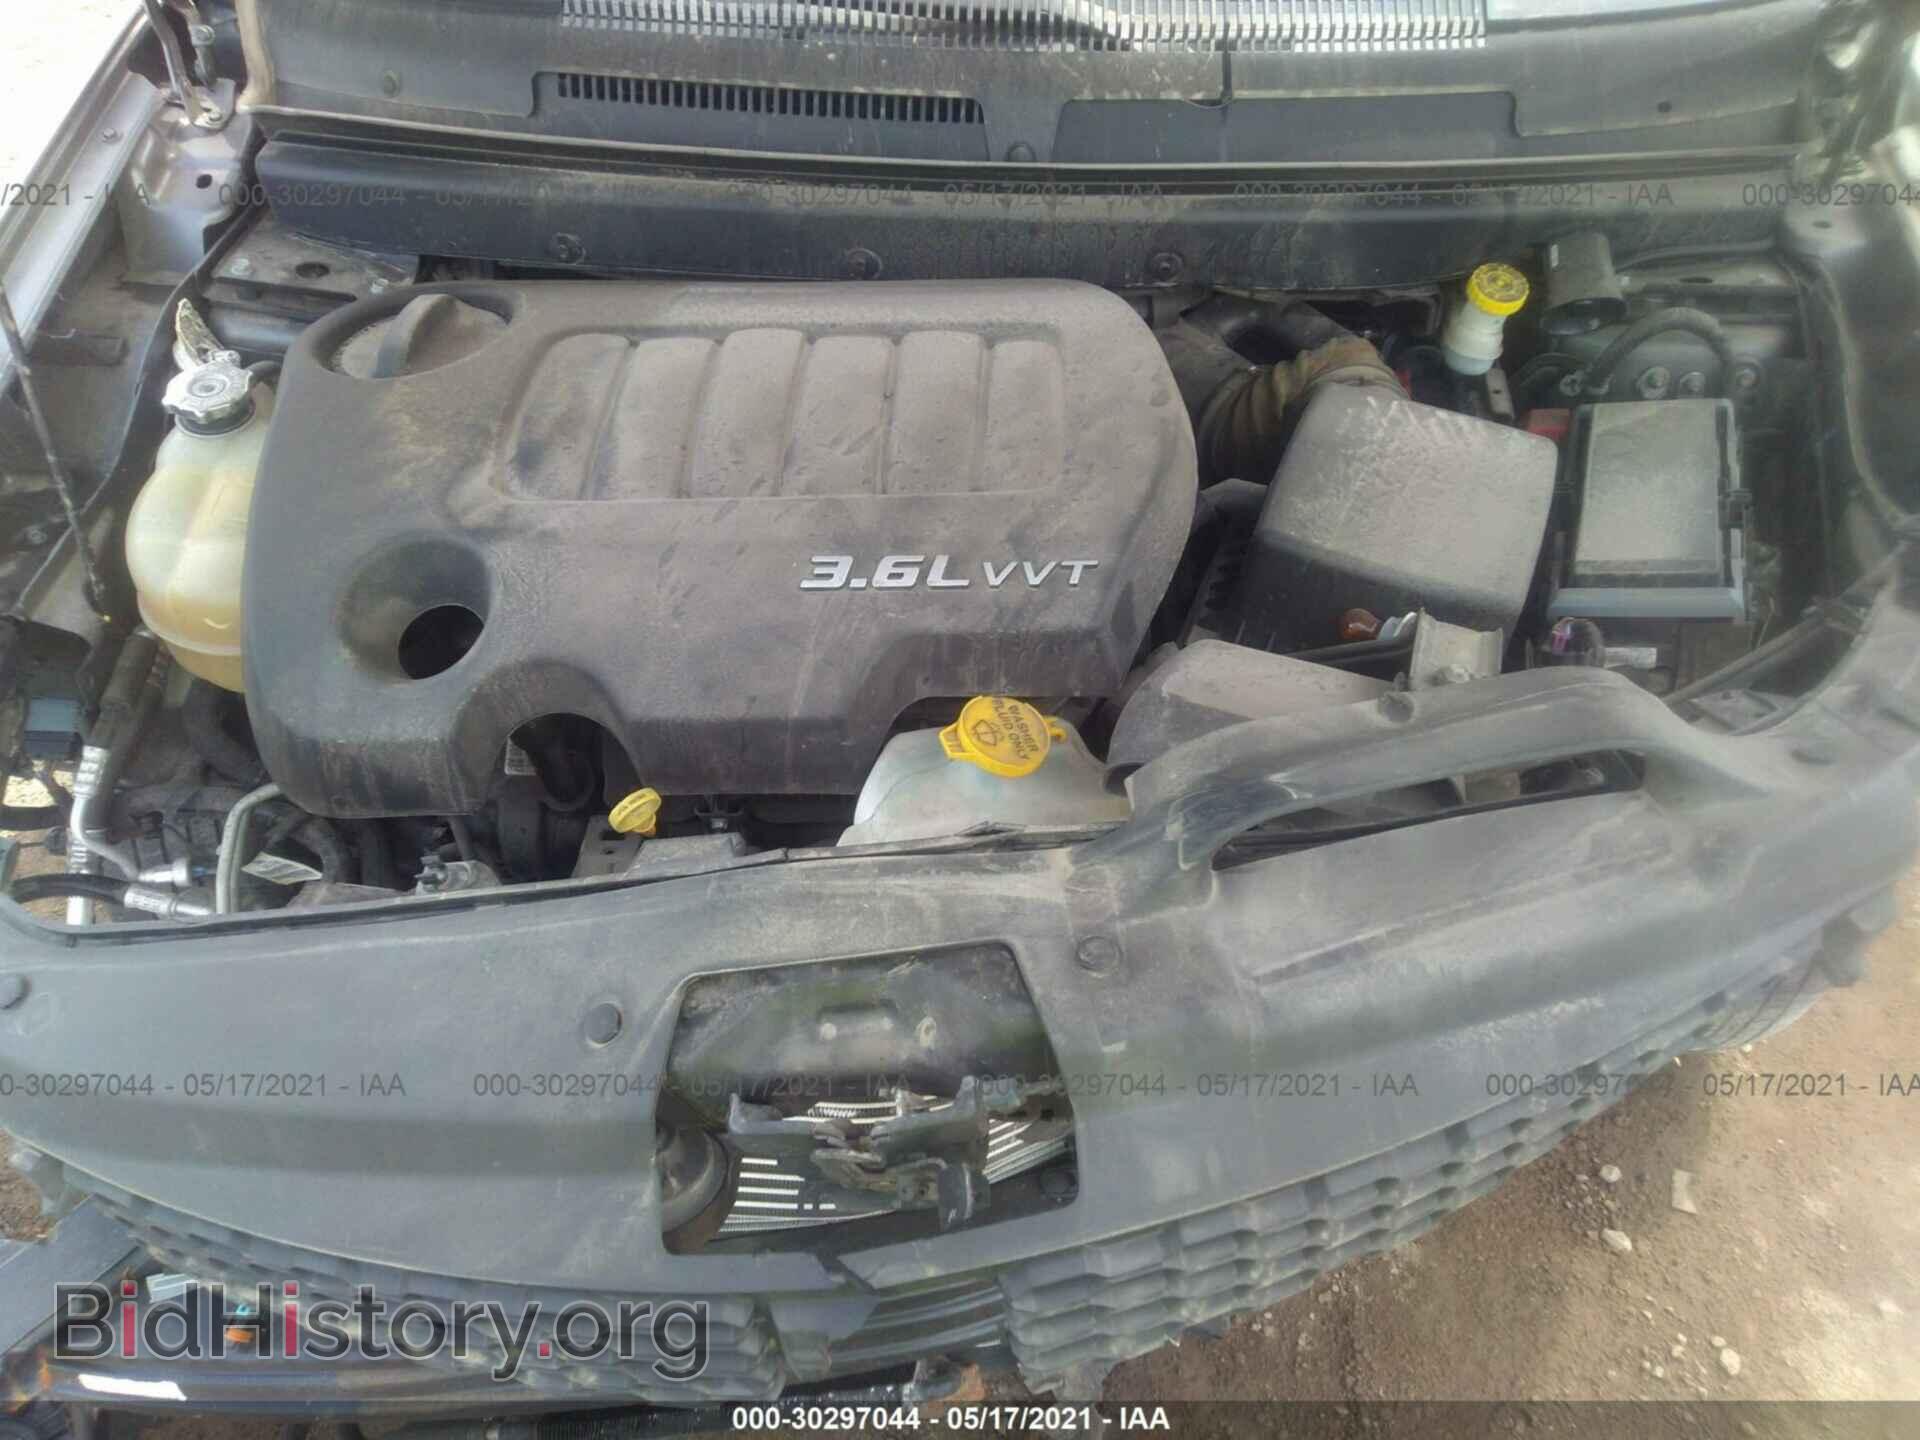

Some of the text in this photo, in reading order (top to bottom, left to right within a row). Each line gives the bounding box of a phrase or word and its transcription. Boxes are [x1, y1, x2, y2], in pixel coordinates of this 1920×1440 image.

[799, 555, 1099, 589] 3.6L VVT
[992, 697, 1031, 760] FLUID ONLY
[1008, 705, 1039, 752] WASHER
